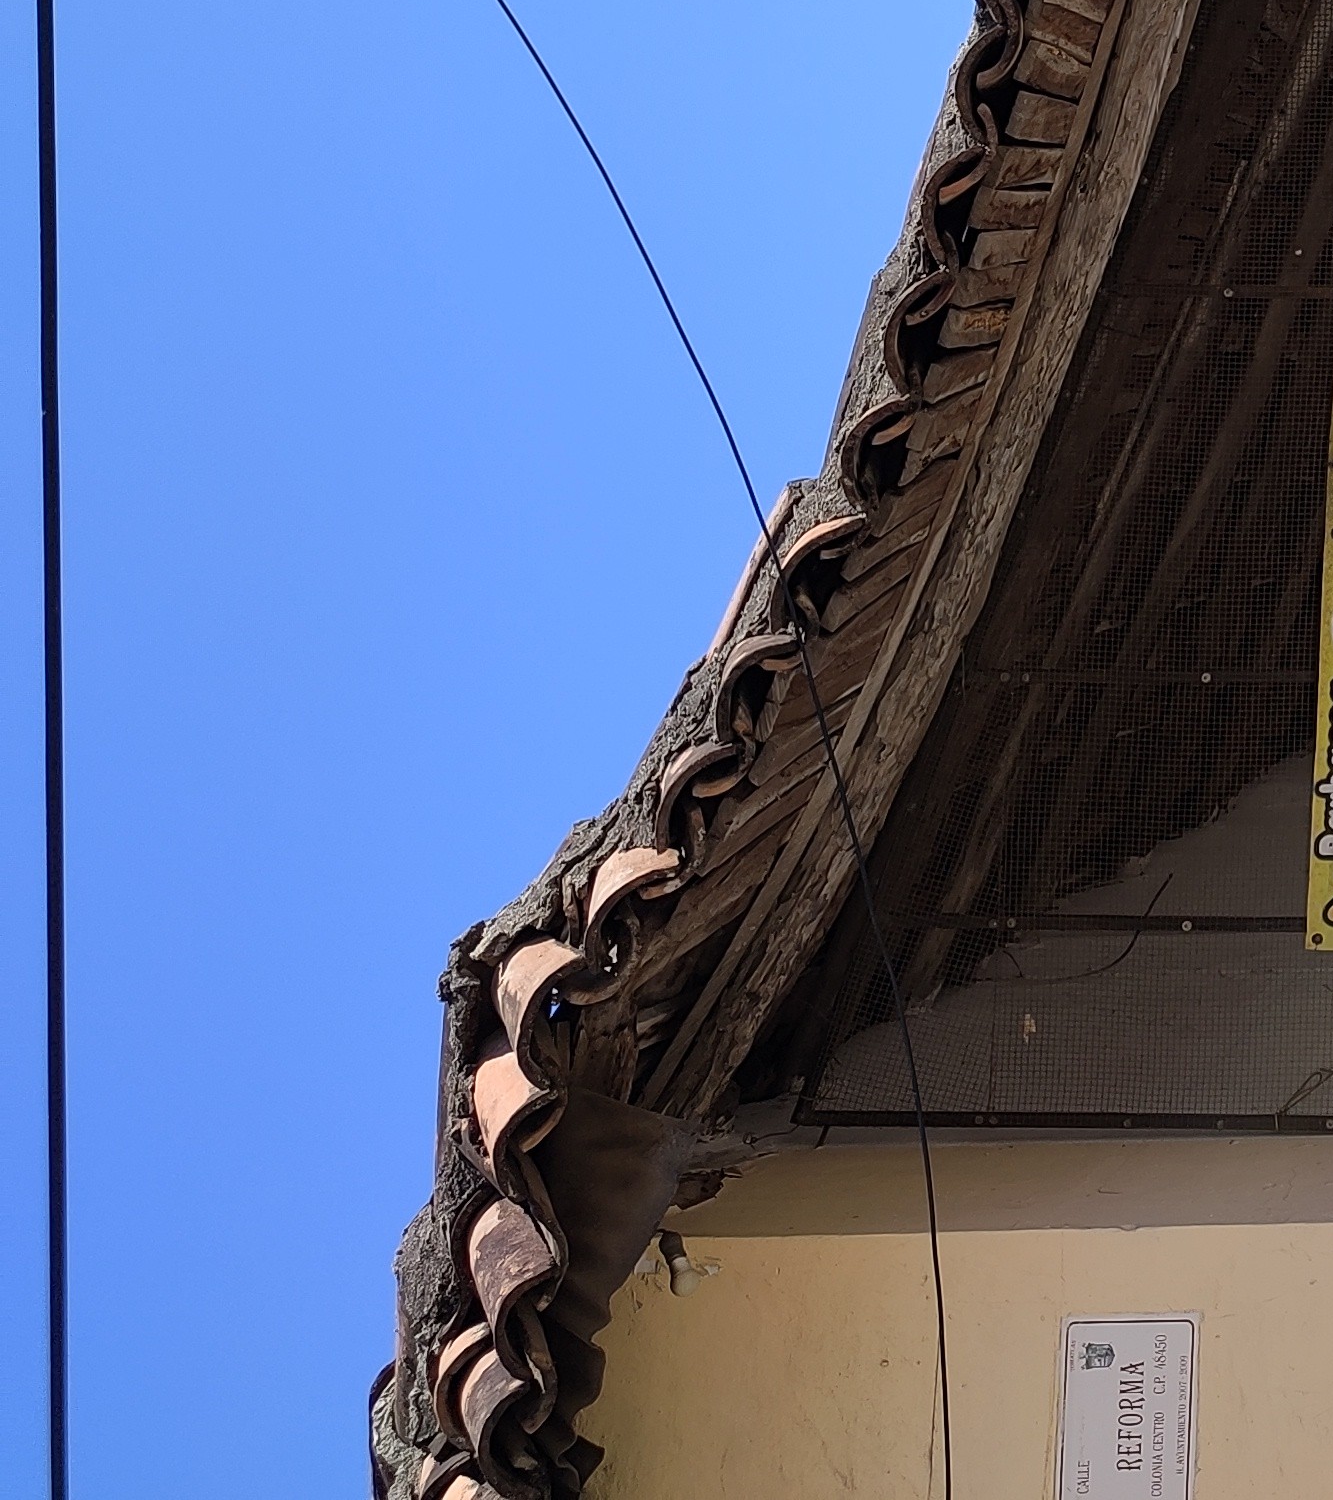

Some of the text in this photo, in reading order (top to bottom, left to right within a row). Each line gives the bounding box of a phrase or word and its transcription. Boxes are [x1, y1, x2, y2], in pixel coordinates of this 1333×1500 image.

[1180, 1355, 1189, 1375] 2009
[1178, 1381, 1187, 1401] 2007
[1116, 1361, 1145, 1471] REFORMA
[1151, 1334, 1168, 1497] COLONIA CENTRO C.P. 48450
[1175, 1404, 1187, 1465] AYUNTAMIENTO
[1076, 1460, 1090, 1494] CALLE
